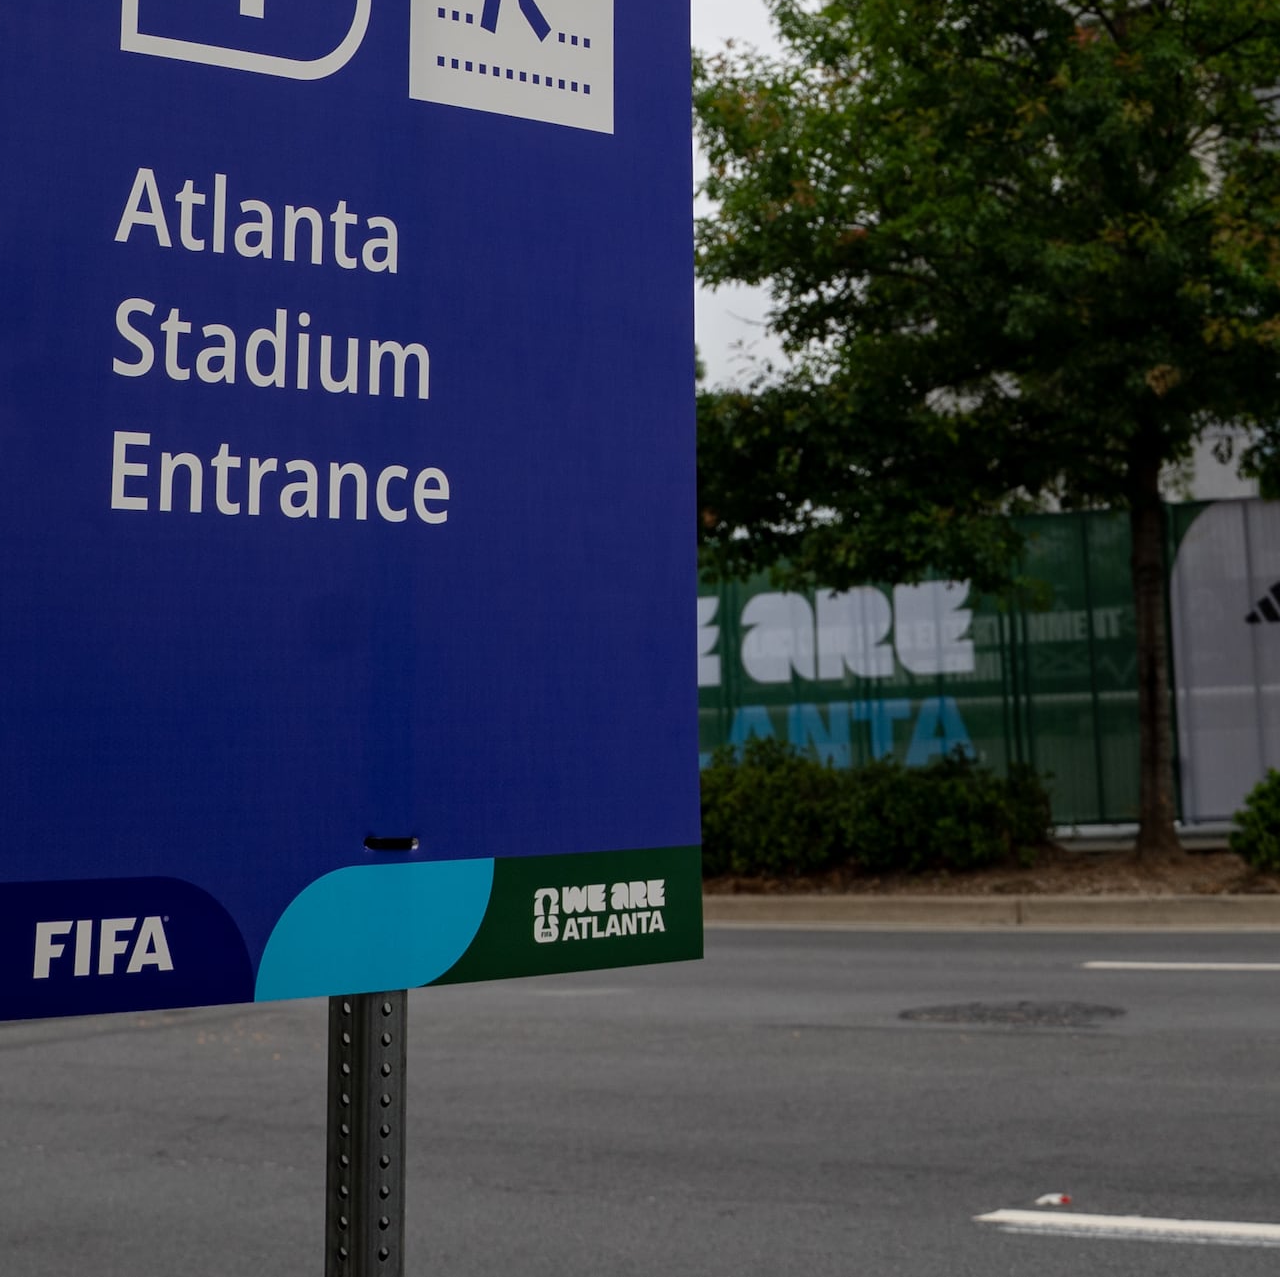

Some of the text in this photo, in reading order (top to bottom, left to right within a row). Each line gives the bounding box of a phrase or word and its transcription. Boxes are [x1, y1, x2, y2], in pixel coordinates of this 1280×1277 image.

[114, 167, 398, 273] Atlanta
[113, 297, 430, 399] Stadium
[111, 431, 450, 524] Entrance
[561, 878, 666, 915] WE ARE
[561, 910, 667, 942] ATLANTA
[32, 915, 175, 980] FIFA
